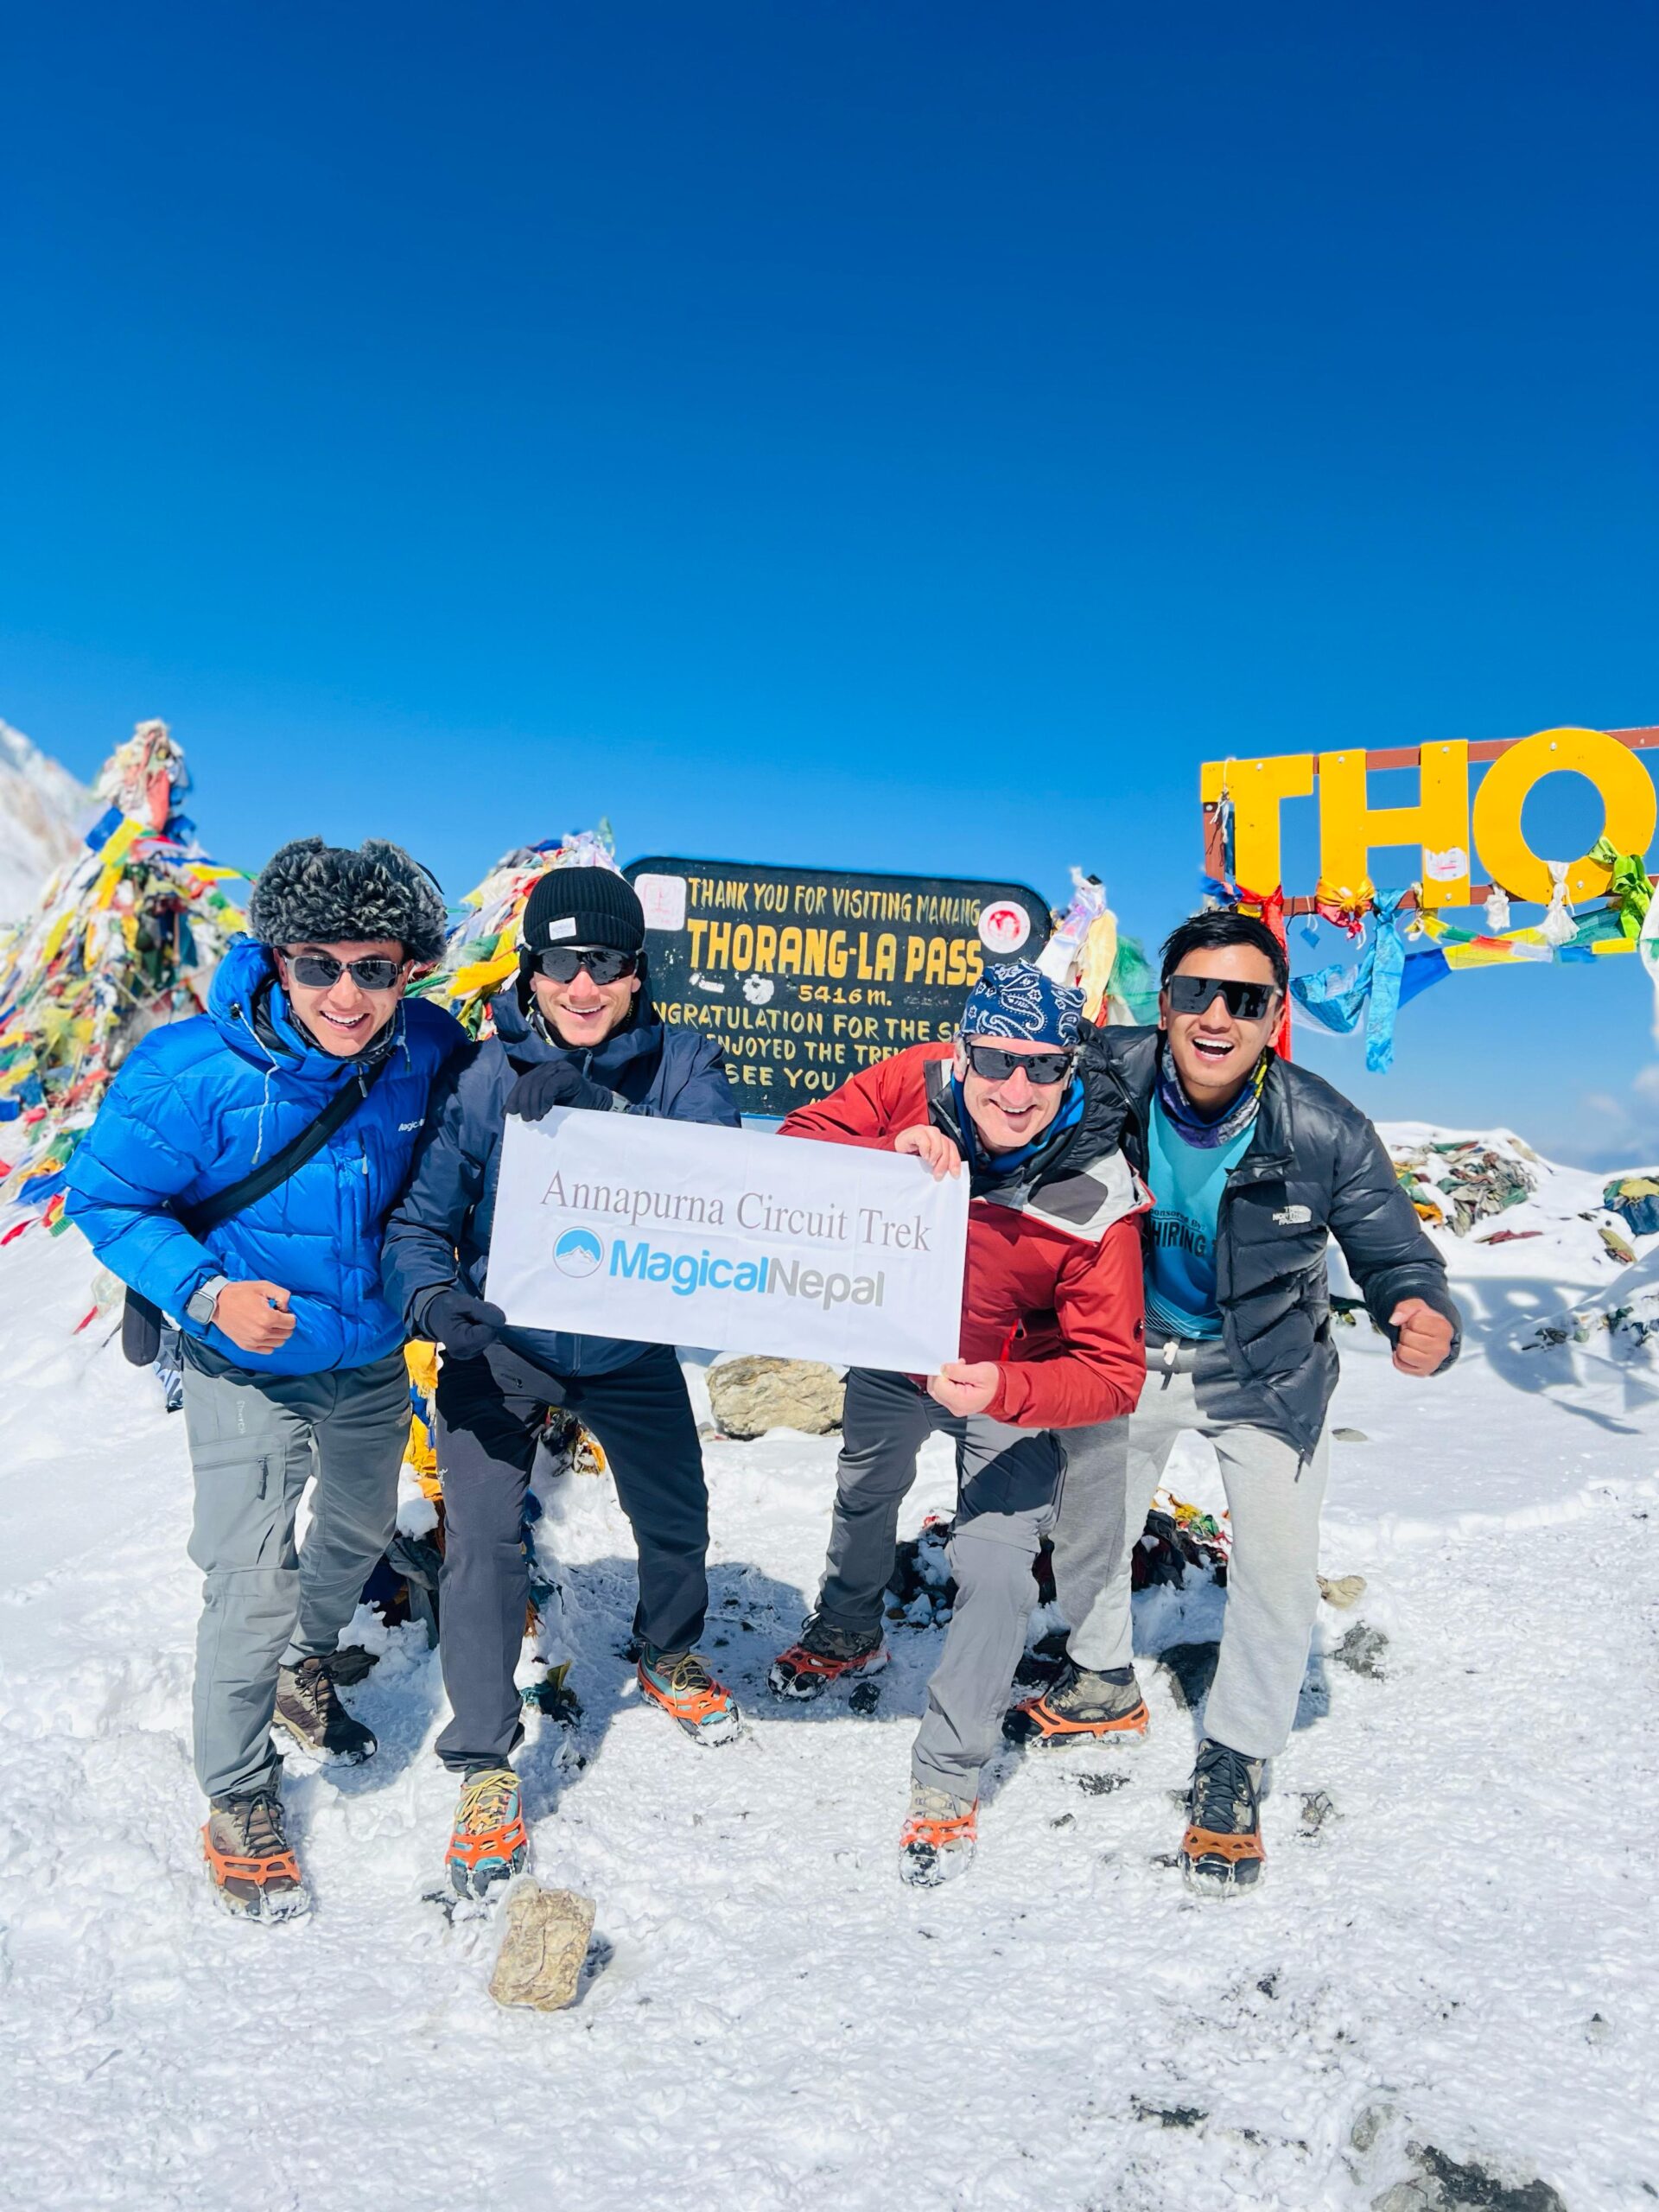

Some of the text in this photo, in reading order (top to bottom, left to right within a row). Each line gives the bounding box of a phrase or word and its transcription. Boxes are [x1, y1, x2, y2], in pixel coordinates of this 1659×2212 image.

[688, 877, 982, 926] THANK YOU FOR VISITING MANANG
[687, 918, 984, 986] THORANG-LA PASS
[798, 984, 862, 1005] 5416
[652, 1001, 823, 1035] NGRATULATION
[833, 1014, 880, 1040] FOR
[885, 1017, 931, 1042] THE
[707, 1033, 796, 1061] NJOYED
[804, 1041, 846, 1064] THE
[724, 1063, 774, 1086] SEE
[783, 1067, 836, 1091] YOU
[539, 1170, 931, 1252] Annapurna Circuit Trek
[1149, 1209, 1189, 1223] ponsored
